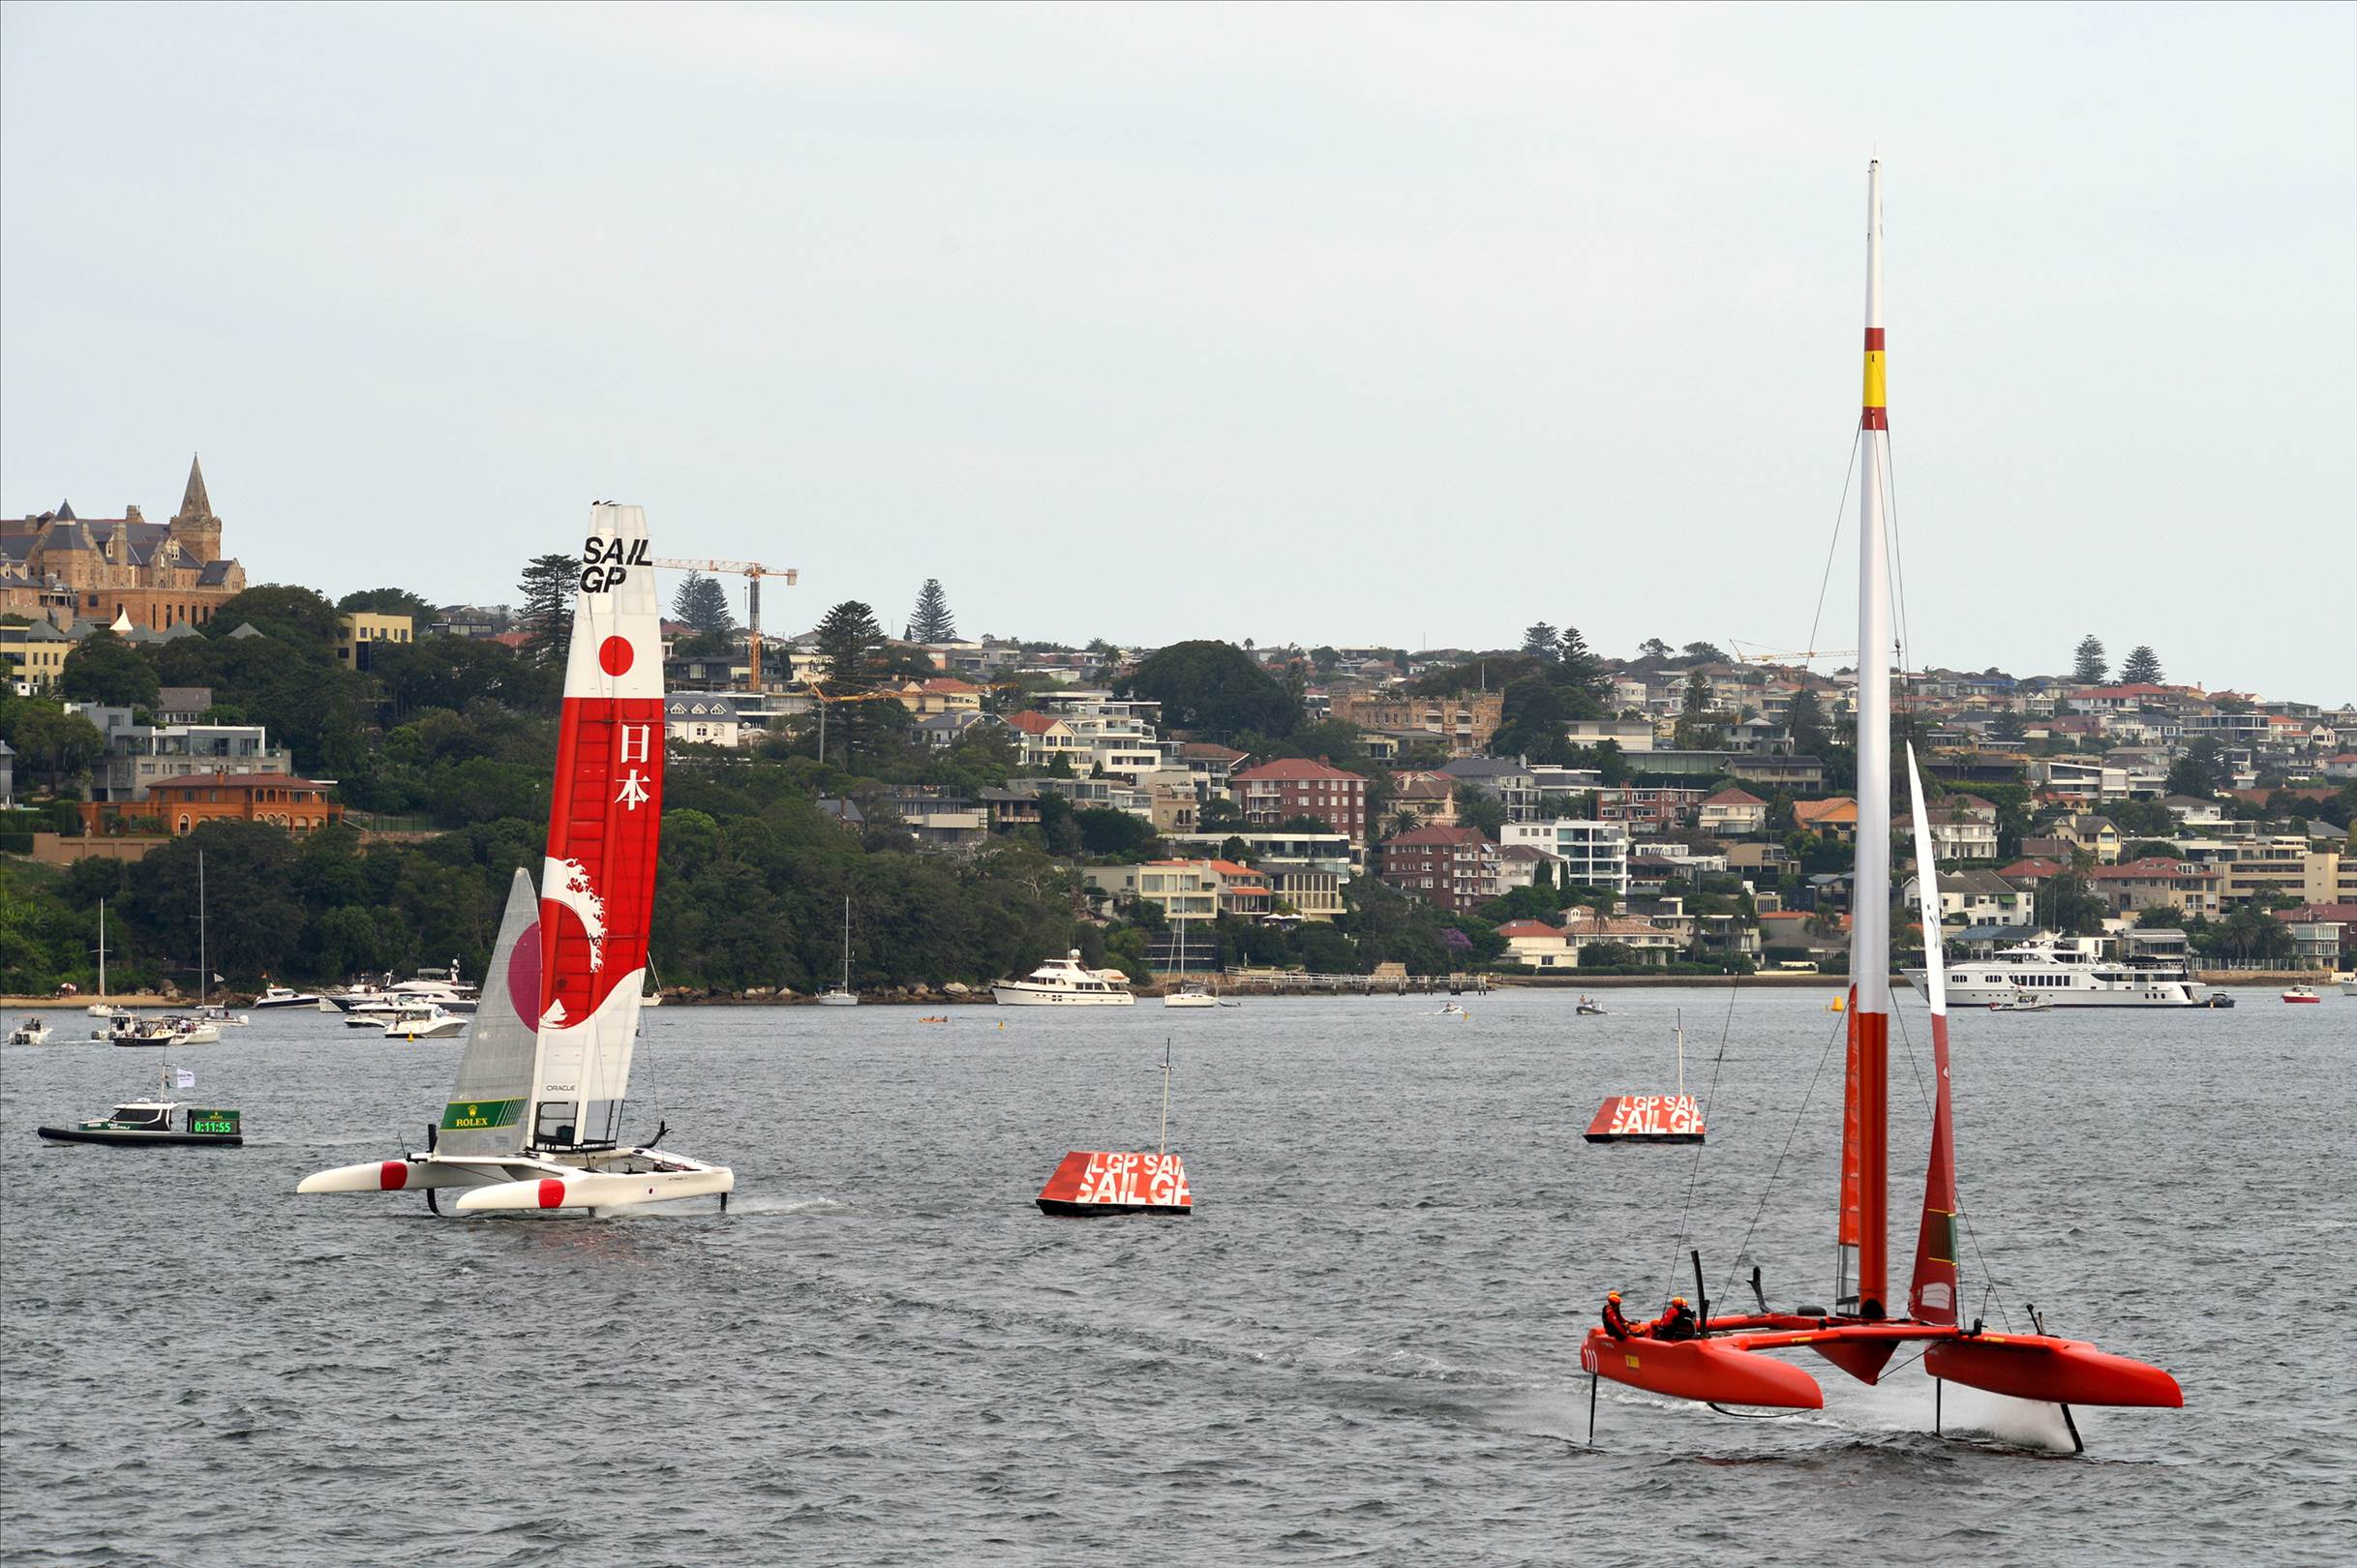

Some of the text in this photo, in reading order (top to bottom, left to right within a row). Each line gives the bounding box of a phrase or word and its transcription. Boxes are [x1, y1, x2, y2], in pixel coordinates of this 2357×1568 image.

[583, 536, 652, 566] SAIL
[580, 566, 627, 593] GP
[614, 724, 650, 811] 日本
[1664, 1096, 1696, 1112] SAI
[195, 1122, 231, 1132] 0:11:55
[456, 1117, 488, 1127] ROLEX
[1142, 1154, 1183, 1176] SAI
